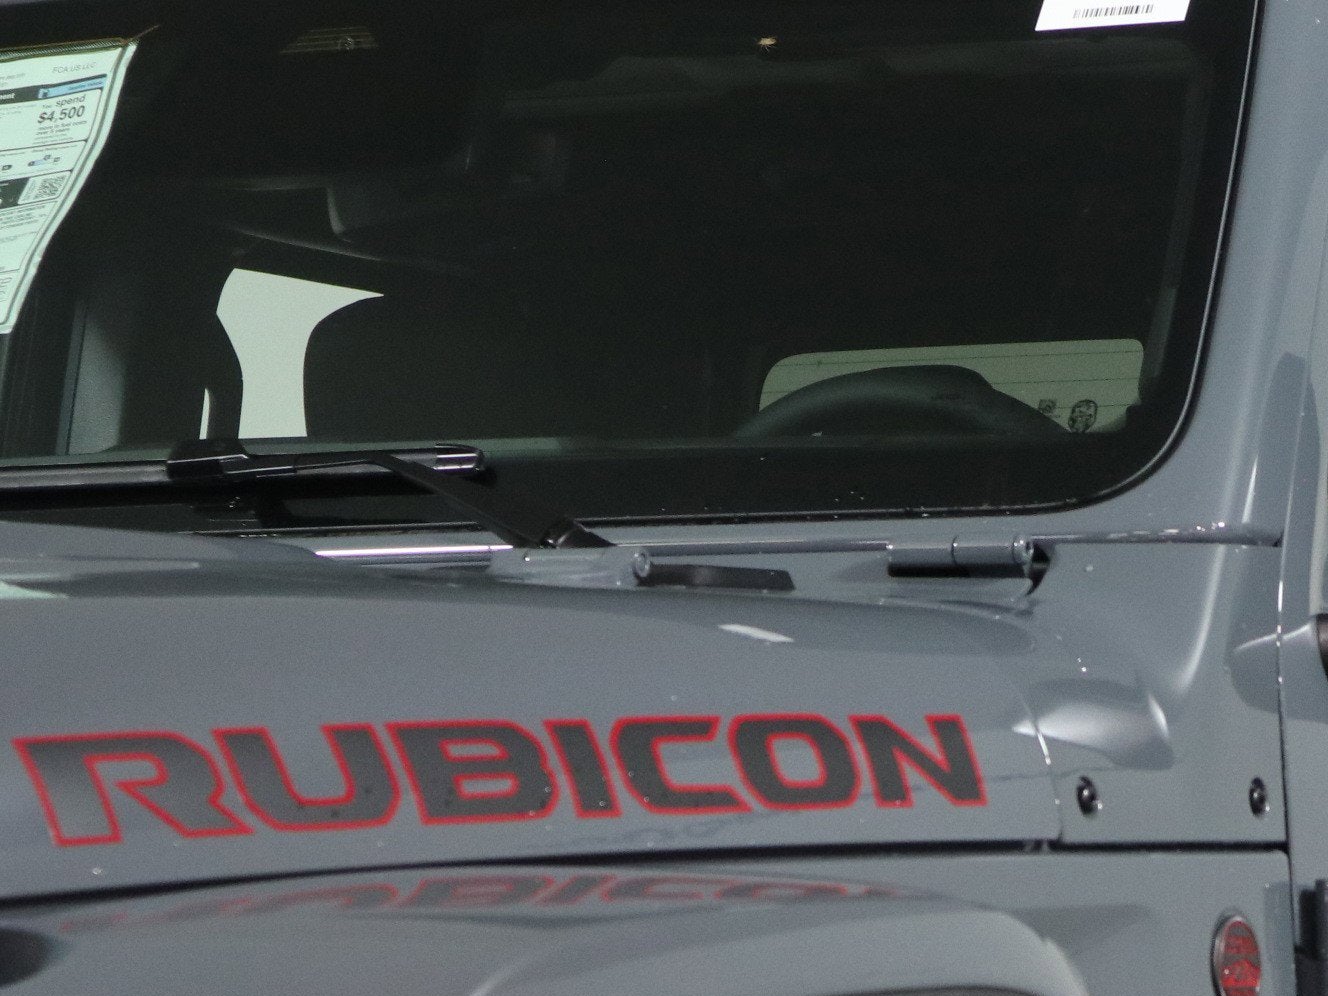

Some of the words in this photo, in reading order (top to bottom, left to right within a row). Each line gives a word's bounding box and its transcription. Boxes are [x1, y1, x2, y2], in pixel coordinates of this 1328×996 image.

[52, 66, 68, 74] FCA
[56, 94, 87, 108] spend
[37, 105, 86, 124] $4,500
[11, 713, 988, 846] RUBICON
